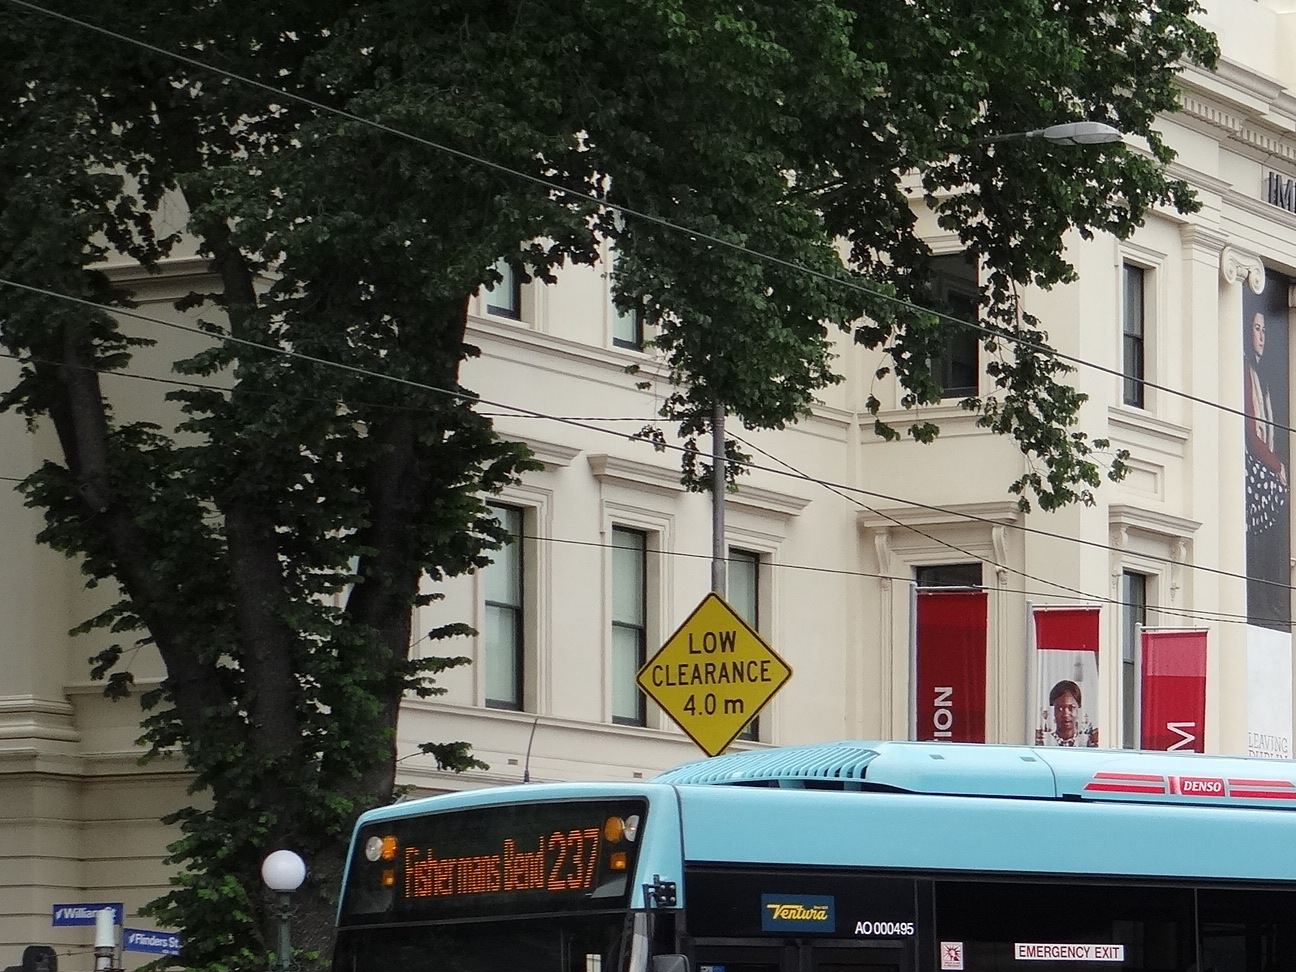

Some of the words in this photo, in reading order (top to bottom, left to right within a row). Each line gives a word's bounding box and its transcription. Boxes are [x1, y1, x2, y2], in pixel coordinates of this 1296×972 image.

[689, 630, 736, 654] LOW
[652, 660, 771, 687] CLEARANCE
[683, 693, 716, 716] 4.0
[724, 698, 744, 714] m
[1248, 732, 1288, 753] LEAVING
[1183, 780, 1222, 793] DENSO
[405, 846, 500, 898] Fishermans
[503, 835, 545, 891] Bend
[547, 828, 600, 891] 237
[767, 904, 828, 920] Ventura
[855, 922, 872, 934] AO
[873, 923, 914, 935] 000495
[134, 934, 168, 948] Flinders
[1019, 946, 1090, 958] EMERGENCY
[1095, 947, 1120, 958] EXIT
